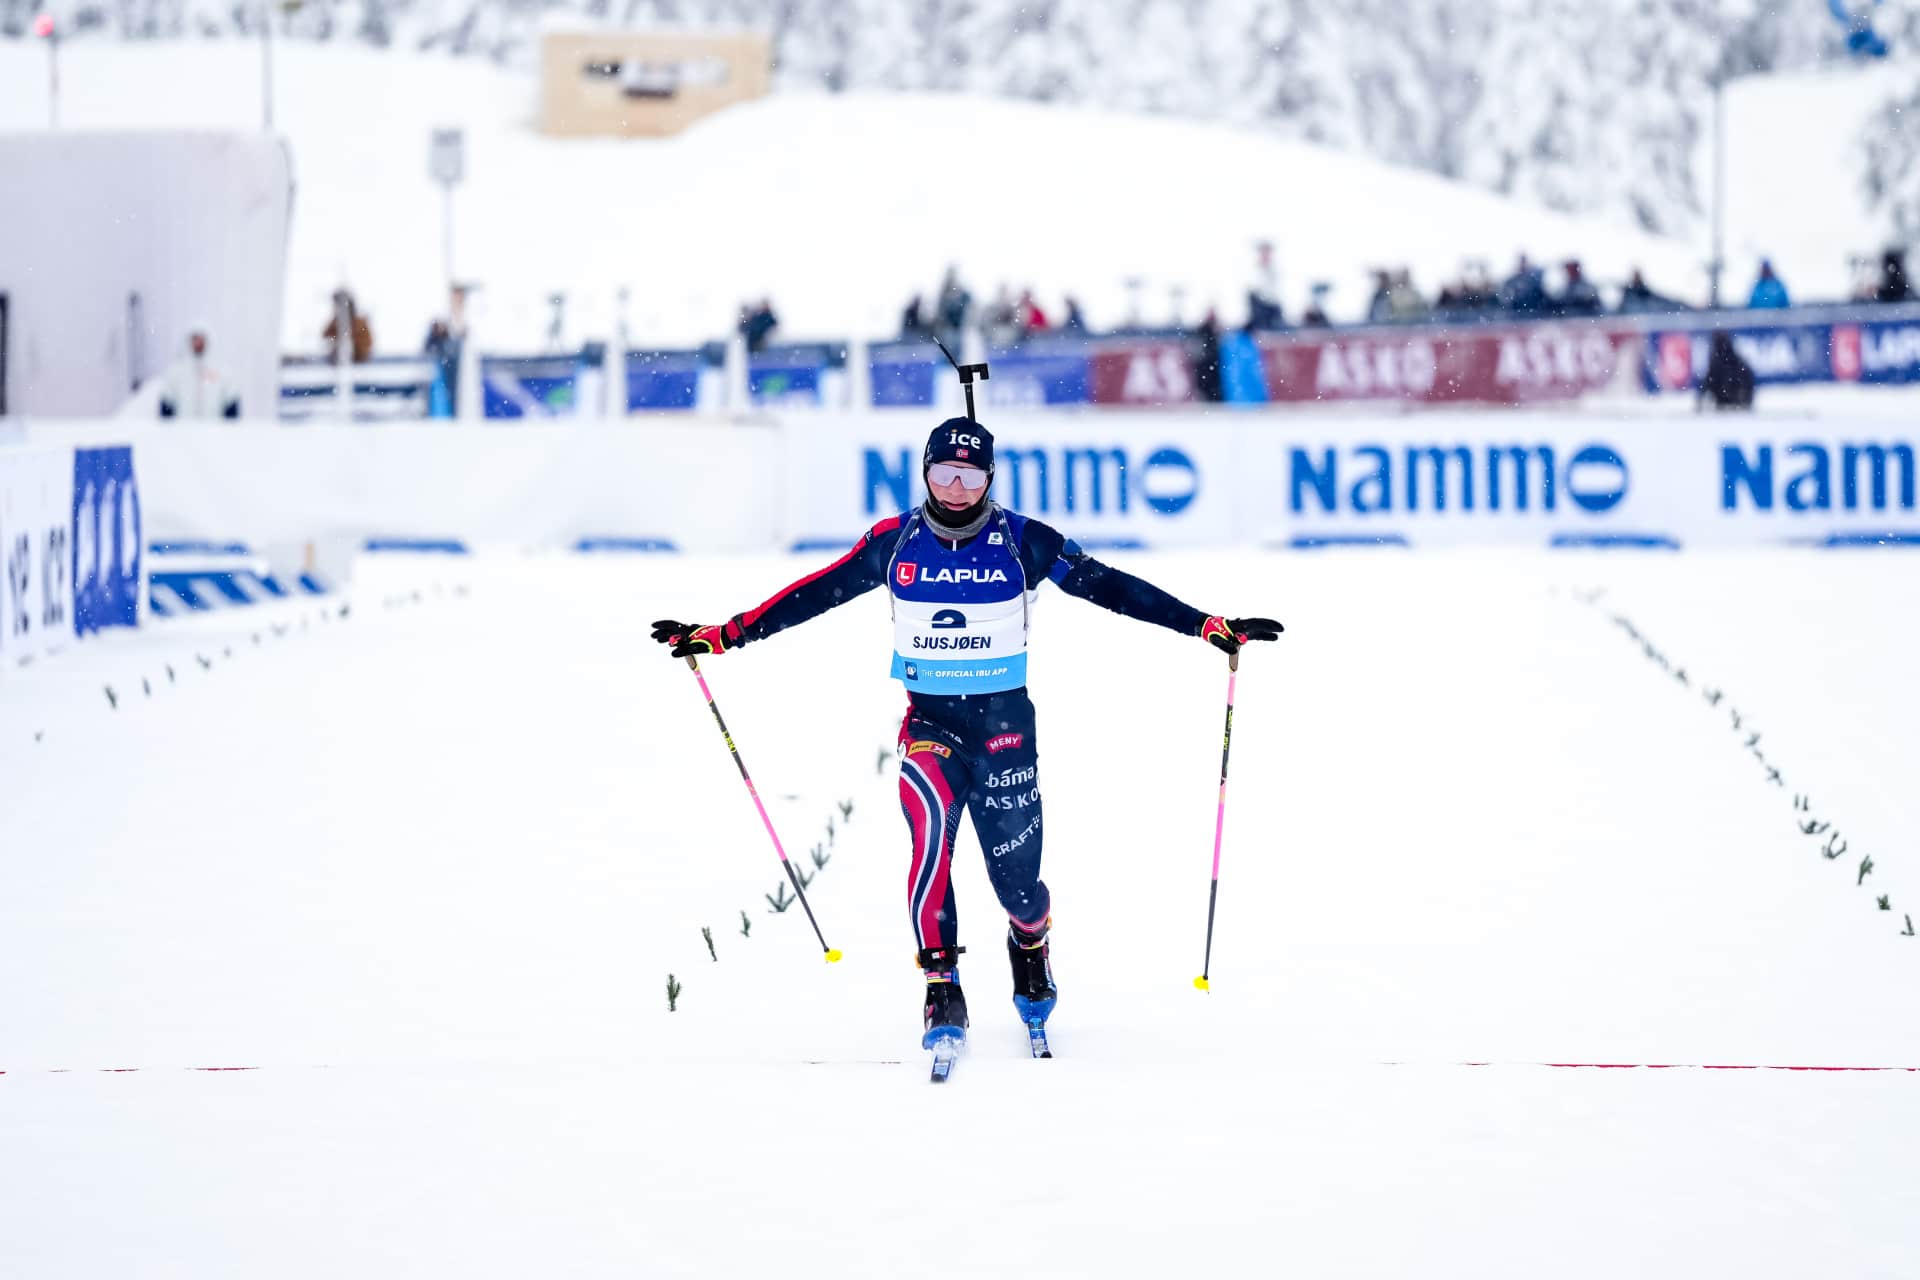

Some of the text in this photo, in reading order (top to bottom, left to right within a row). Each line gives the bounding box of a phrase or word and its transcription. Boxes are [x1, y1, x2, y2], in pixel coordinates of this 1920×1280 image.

[949, 428, 981, 449] ice
[864, 445, 1198, 515] Nmmo
[1289, 445, 1628, 514] Nammo
[920, 567, 1008, 583] LAPUA
[912, 635, 992, 650] SJUSJØEN
[935, 669, 974, 678] OFFICIAL
[991, 666, 1009, 676] APP
[989, 735, 1019, 750] MENY
[992, 823, 1035, 857] CRAFT
